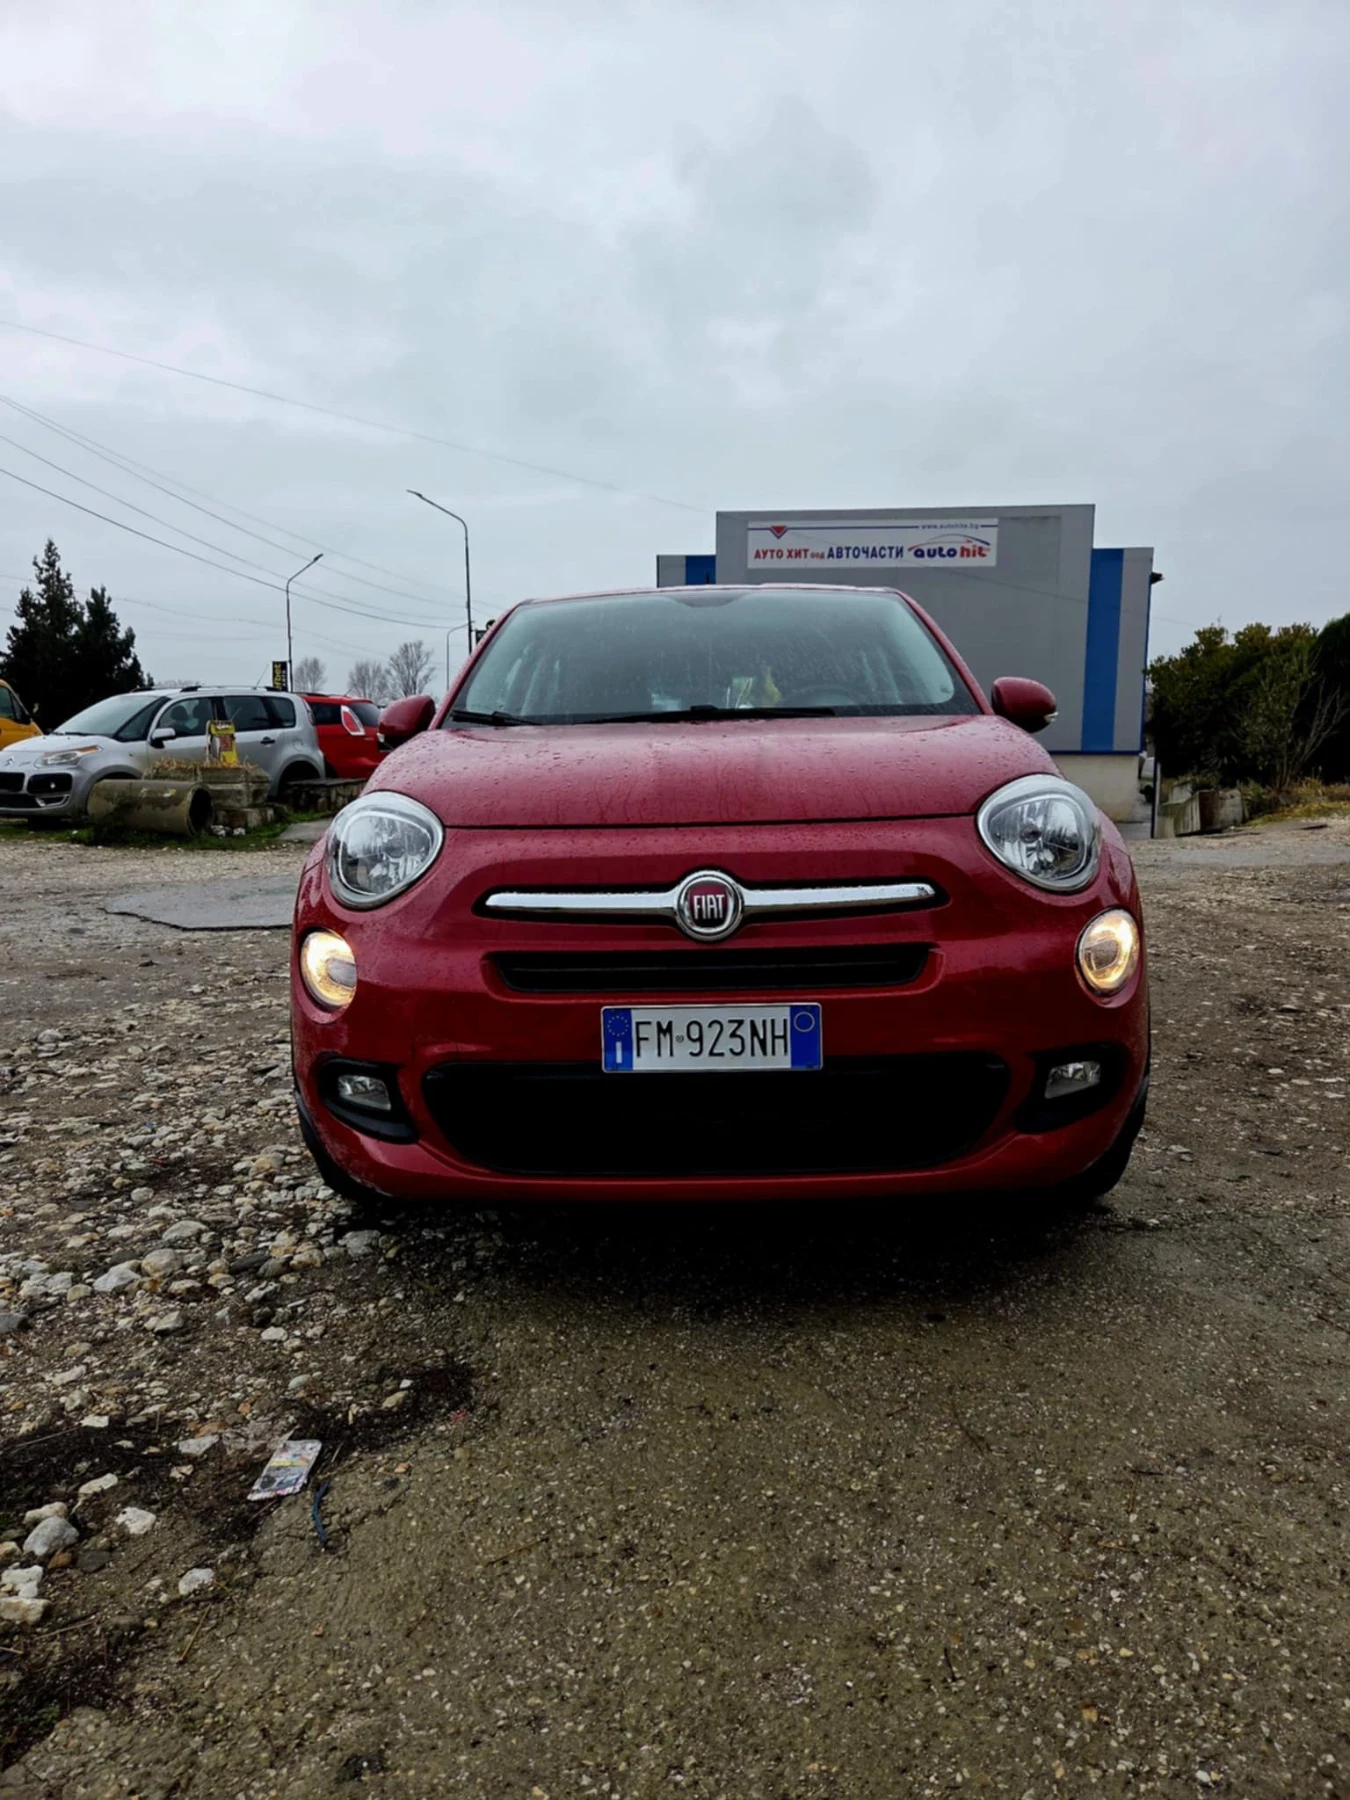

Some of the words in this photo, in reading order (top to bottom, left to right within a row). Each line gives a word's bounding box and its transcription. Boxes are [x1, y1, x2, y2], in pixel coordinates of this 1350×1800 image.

[754, 549, 784, 560] АУТО
[786, 548, 809, 559] ХИТ
[827, 545, 904, 560] АВТОЧАСТИ
[693, 894, 725, 919] FIAT
